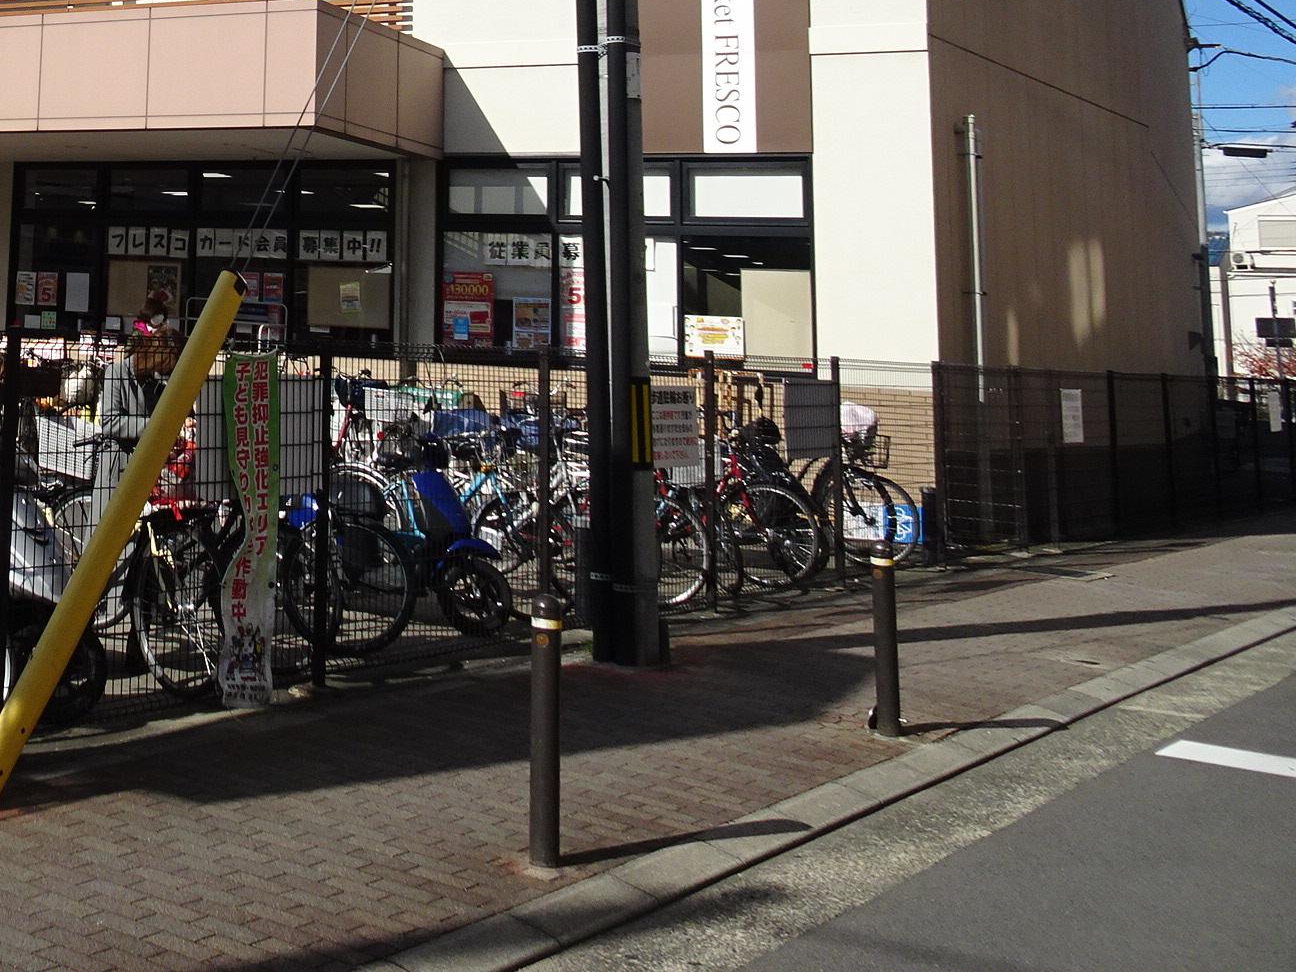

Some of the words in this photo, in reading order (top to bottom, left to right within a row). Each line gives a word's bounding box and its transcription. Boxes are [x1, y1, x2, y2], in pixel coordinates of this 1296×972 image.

[714, 35, 741, 145] FRESCO
[111, 232, 186, 251] フレスコ
[250, 361, 270, 555] 犯罪抑止強化エリア
